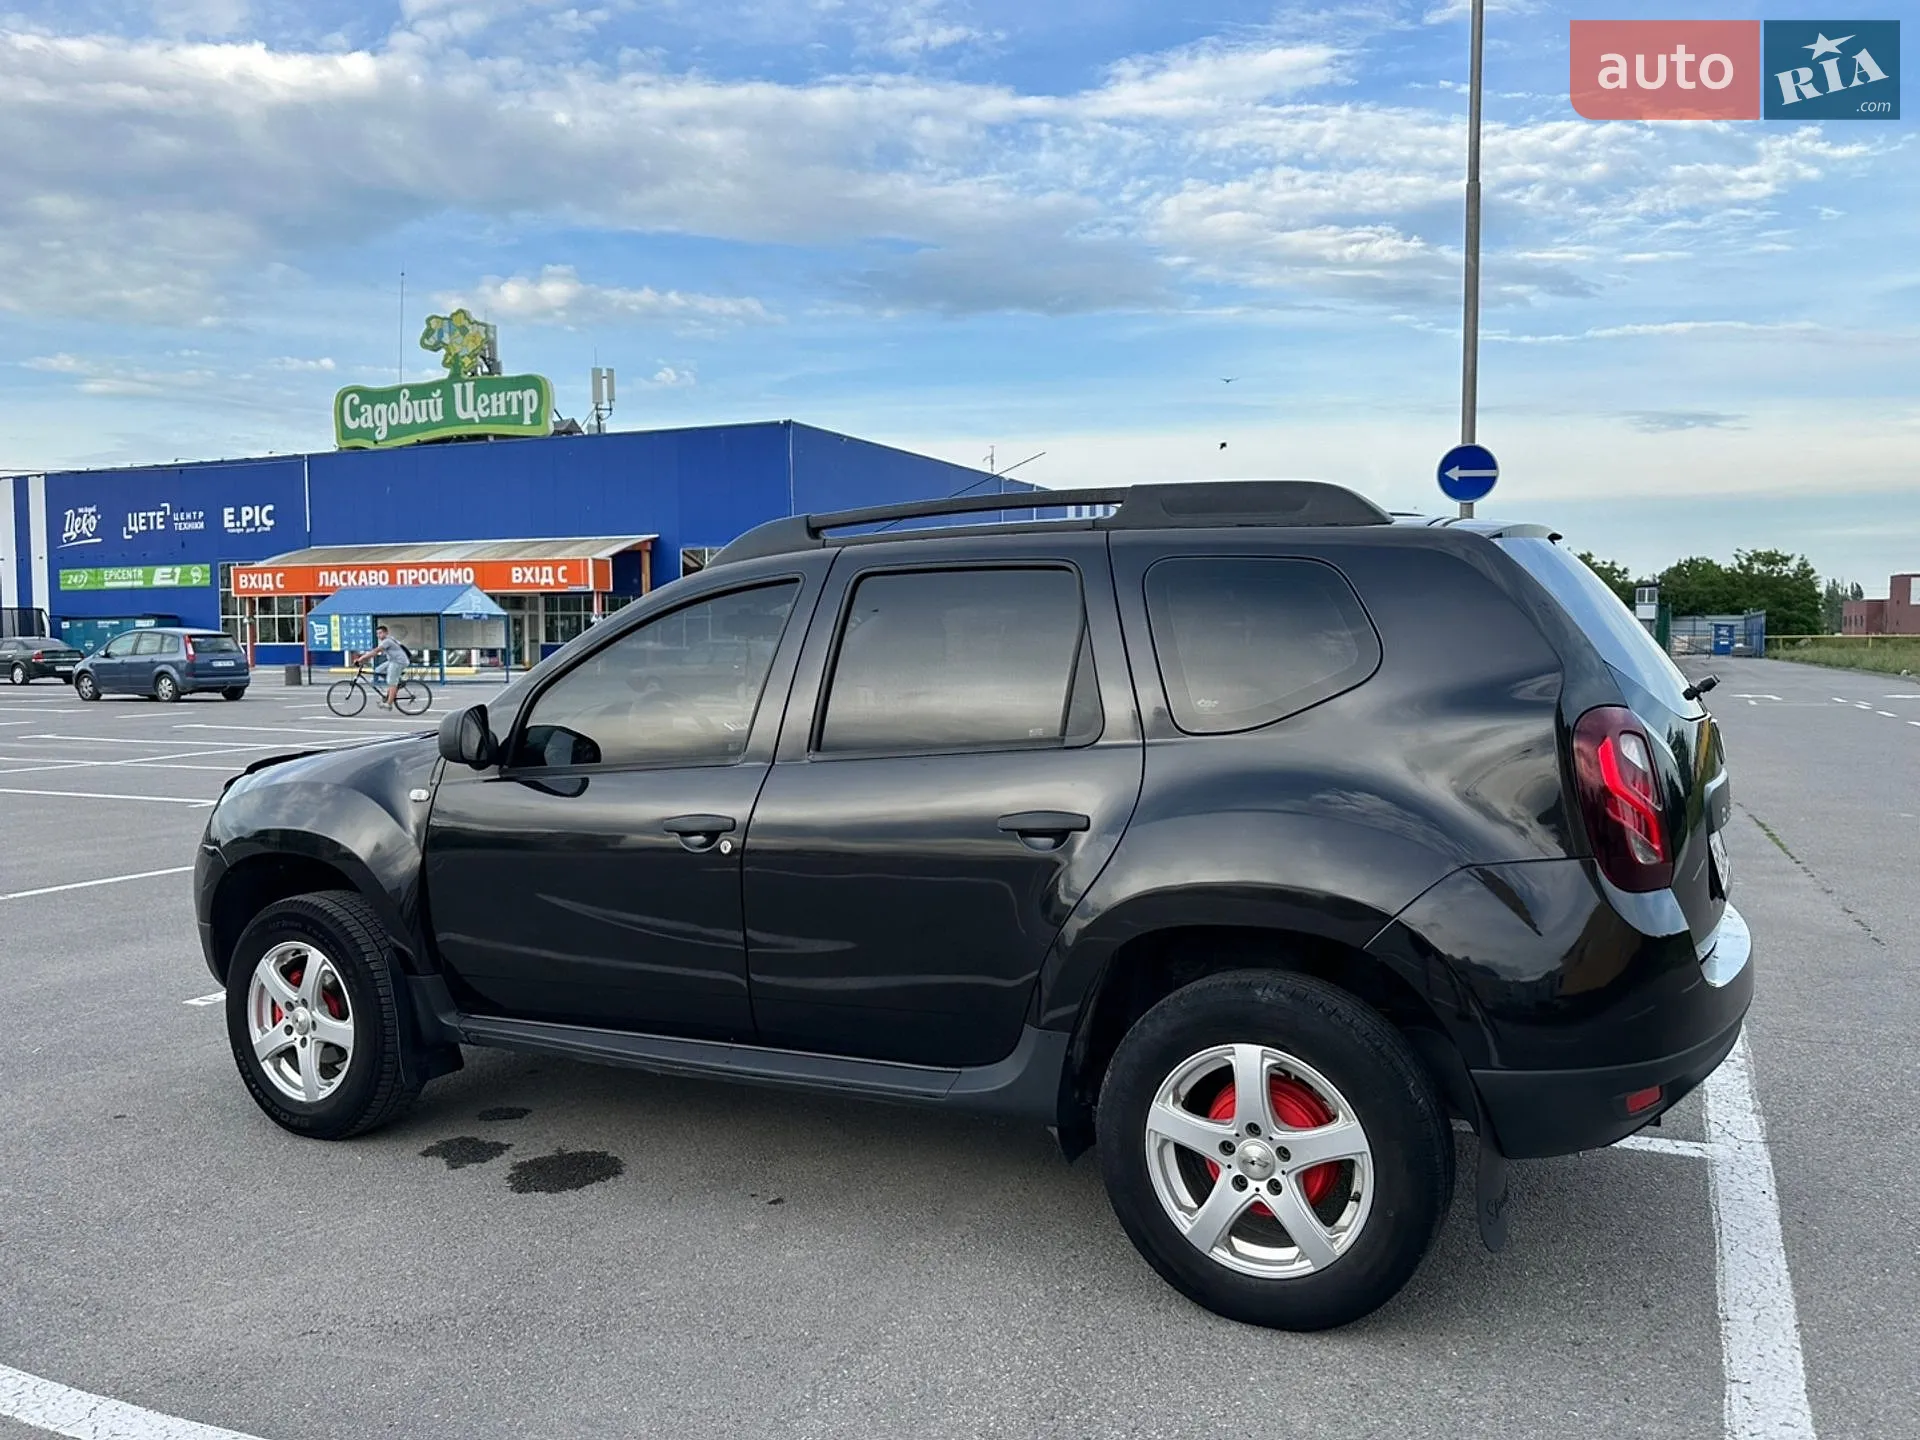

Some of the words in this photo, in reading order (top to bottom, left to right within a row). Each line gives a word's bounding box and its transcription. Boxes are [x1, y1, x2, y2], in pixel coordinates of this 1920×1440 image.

[343, 387, 444, 441] Садовий
[453, 381, 539, 425] Центр
[128, 511, 166, 533] ЦЕТЕ
[173, 511, 204, 521] ЦЕНТР
[223, 504, 275, 528] E.PIC
[239, 573, 274, 591] ВХІД
[318, 569, 389, 587] ЛАСКАВО
[396, 567, 475, 585] ПРОСИМО
[511, 566, 555, 586] ВХІД
